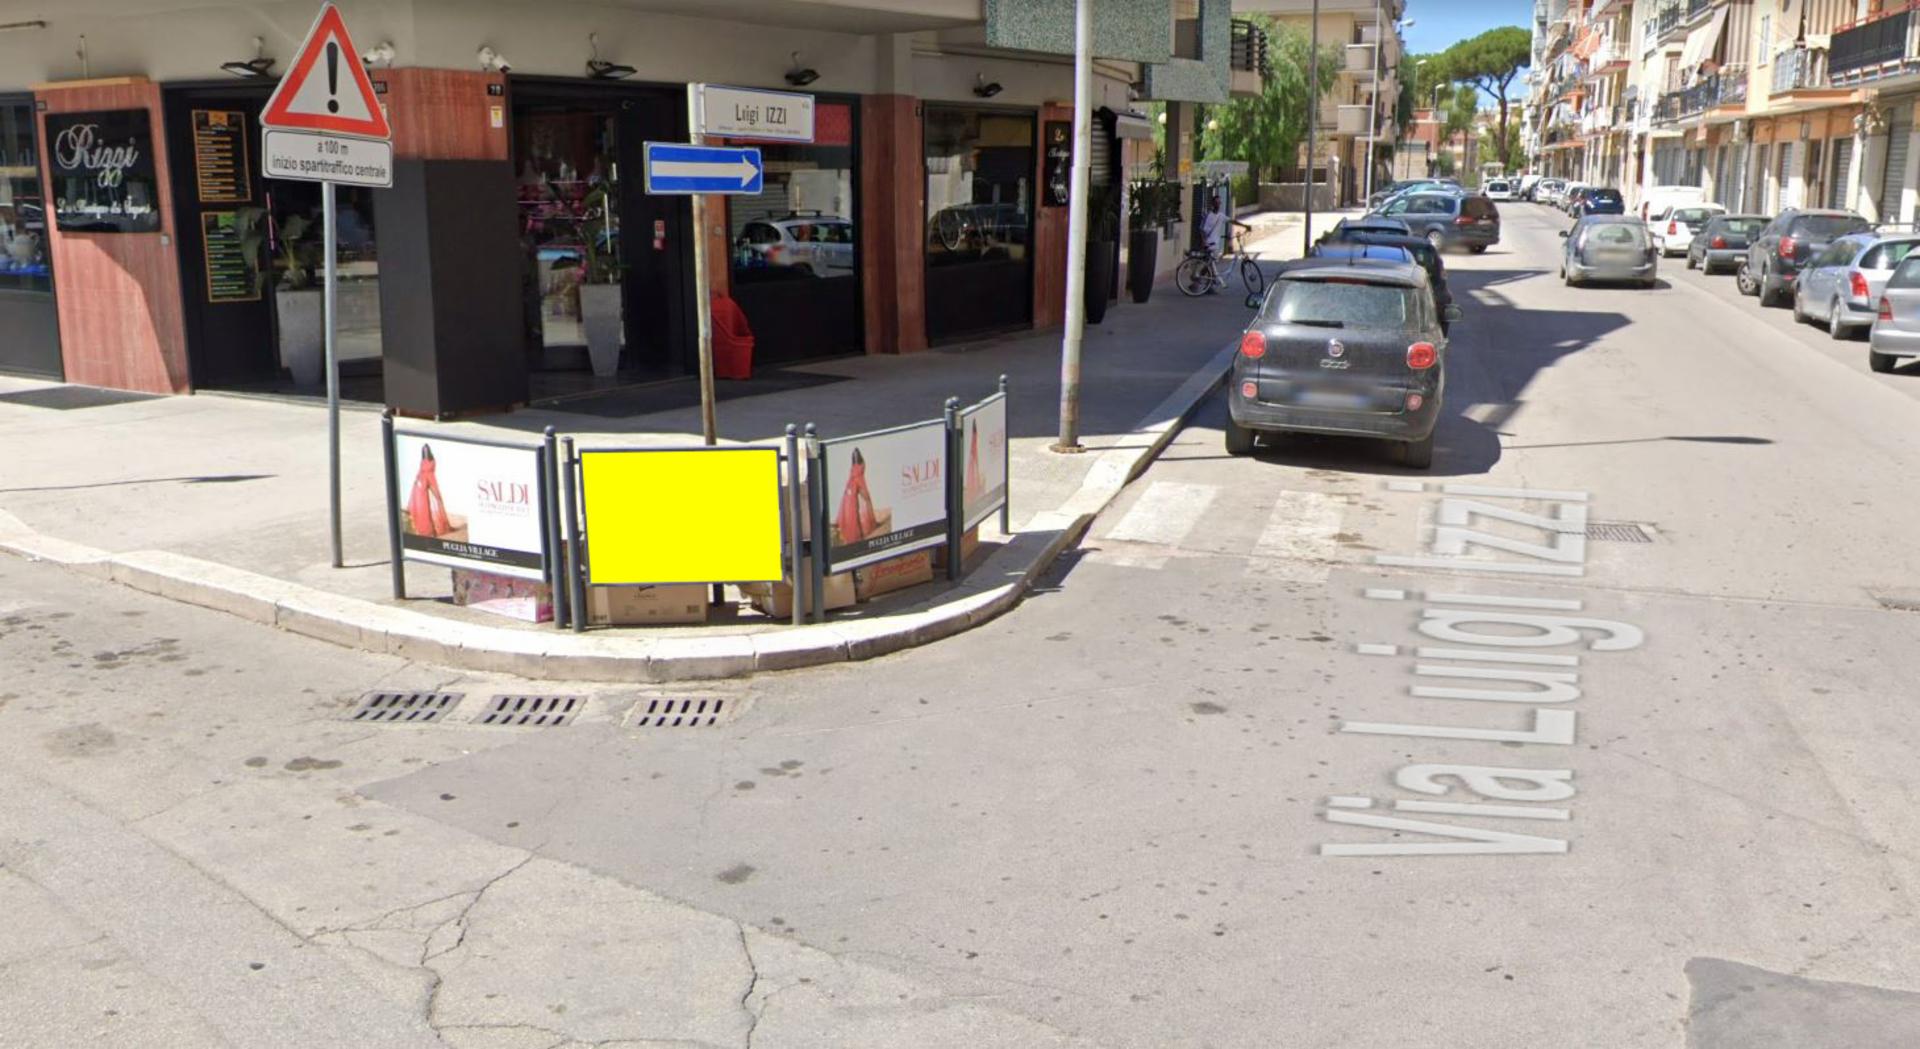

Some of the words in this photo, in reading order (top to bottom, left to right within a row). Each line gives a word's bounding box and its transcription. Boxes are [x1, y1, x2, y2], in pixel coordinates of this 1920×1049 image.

[735, 103, 759, 125] Luigi
[766, 106, 787, 125] IZZI
[56, 124, 139, 188] Rizzi
[317, 141, 323, 153] a
[324, 140, 339, 154] 100
[340, 144, 349, 155] m
[272, 154, 298, 170] inizio
[299, 158, 354, 176] spartitraffico
[354, 163, 387, 178] centrale
[901, 456, 941, 485] SALDI
[477, 479, 529, 505] SALDI
